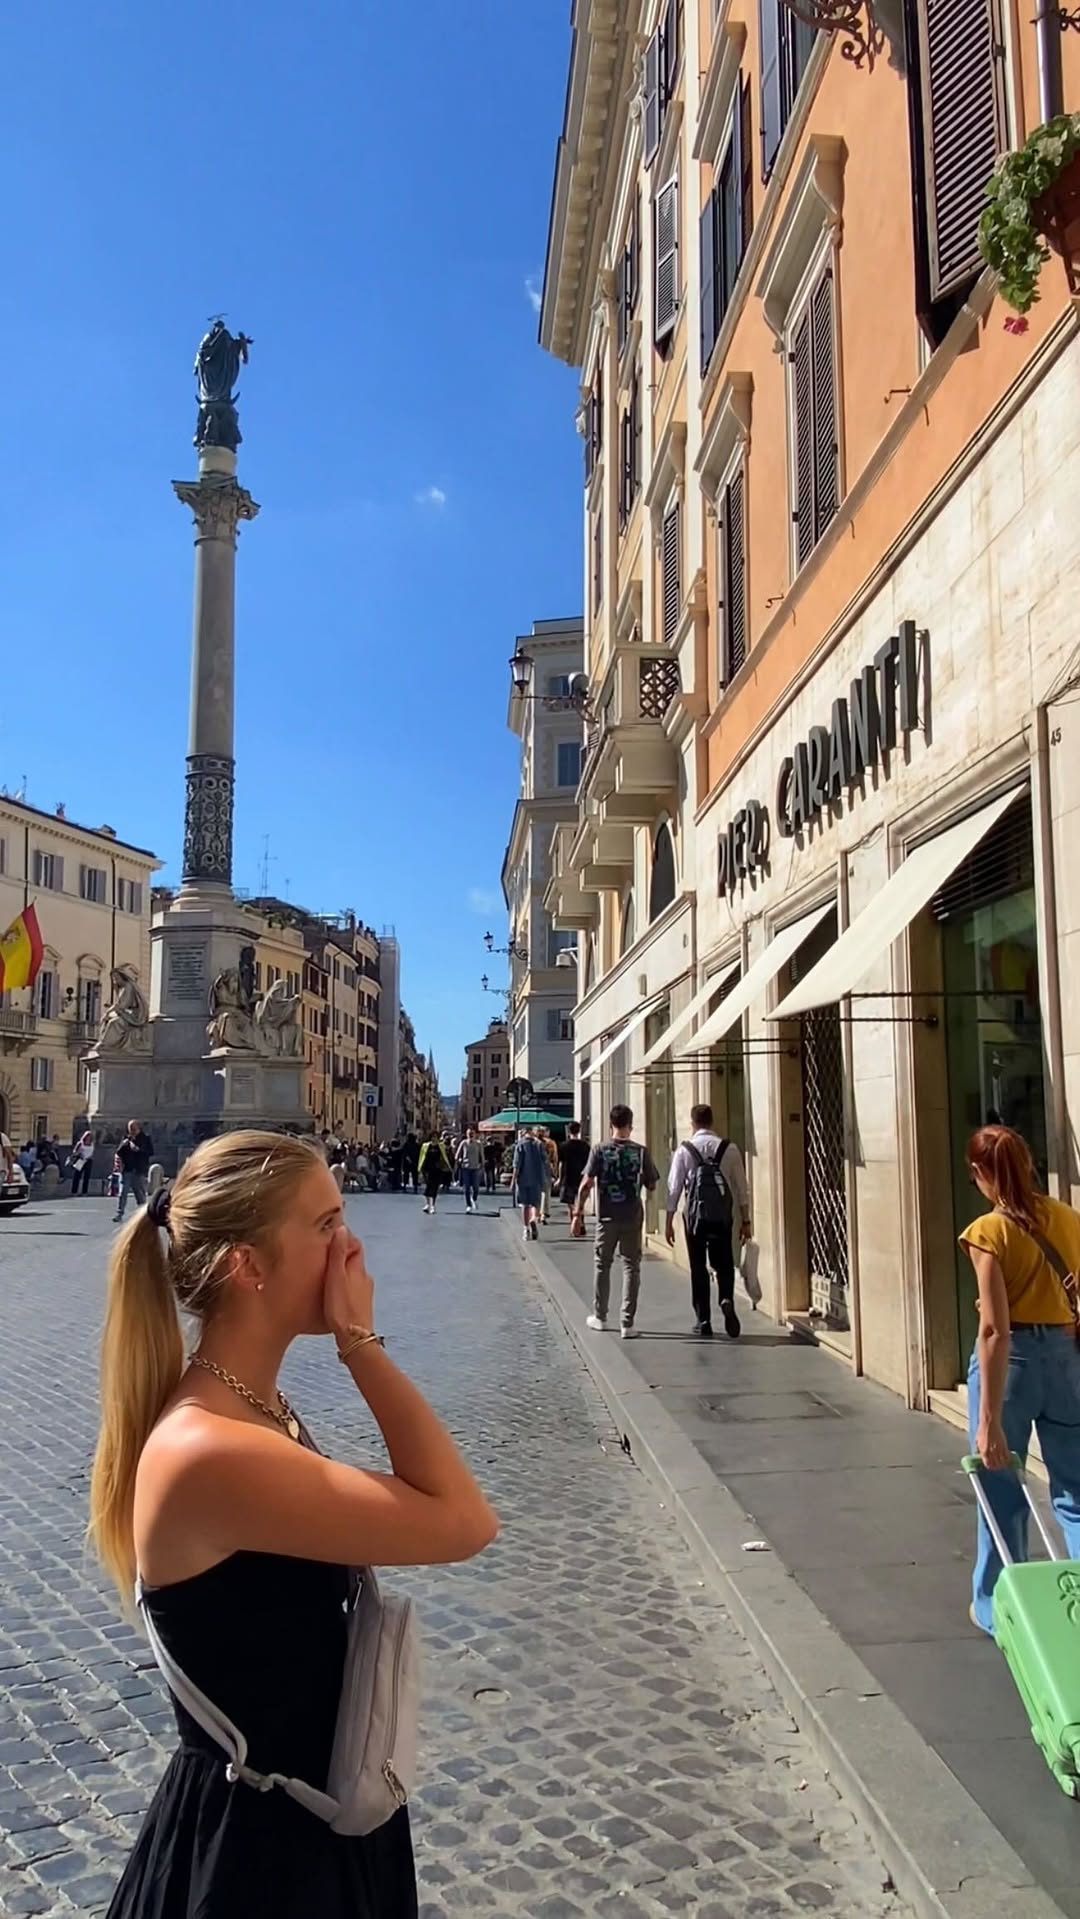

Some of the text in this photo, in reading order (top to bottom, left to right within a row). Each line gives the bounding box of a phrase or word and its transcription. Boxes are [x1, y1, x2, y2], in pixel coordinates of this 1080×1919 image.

[717, 620, 919, 898] PIER CARANTI
[1050, 726, 1062, 747] 45
